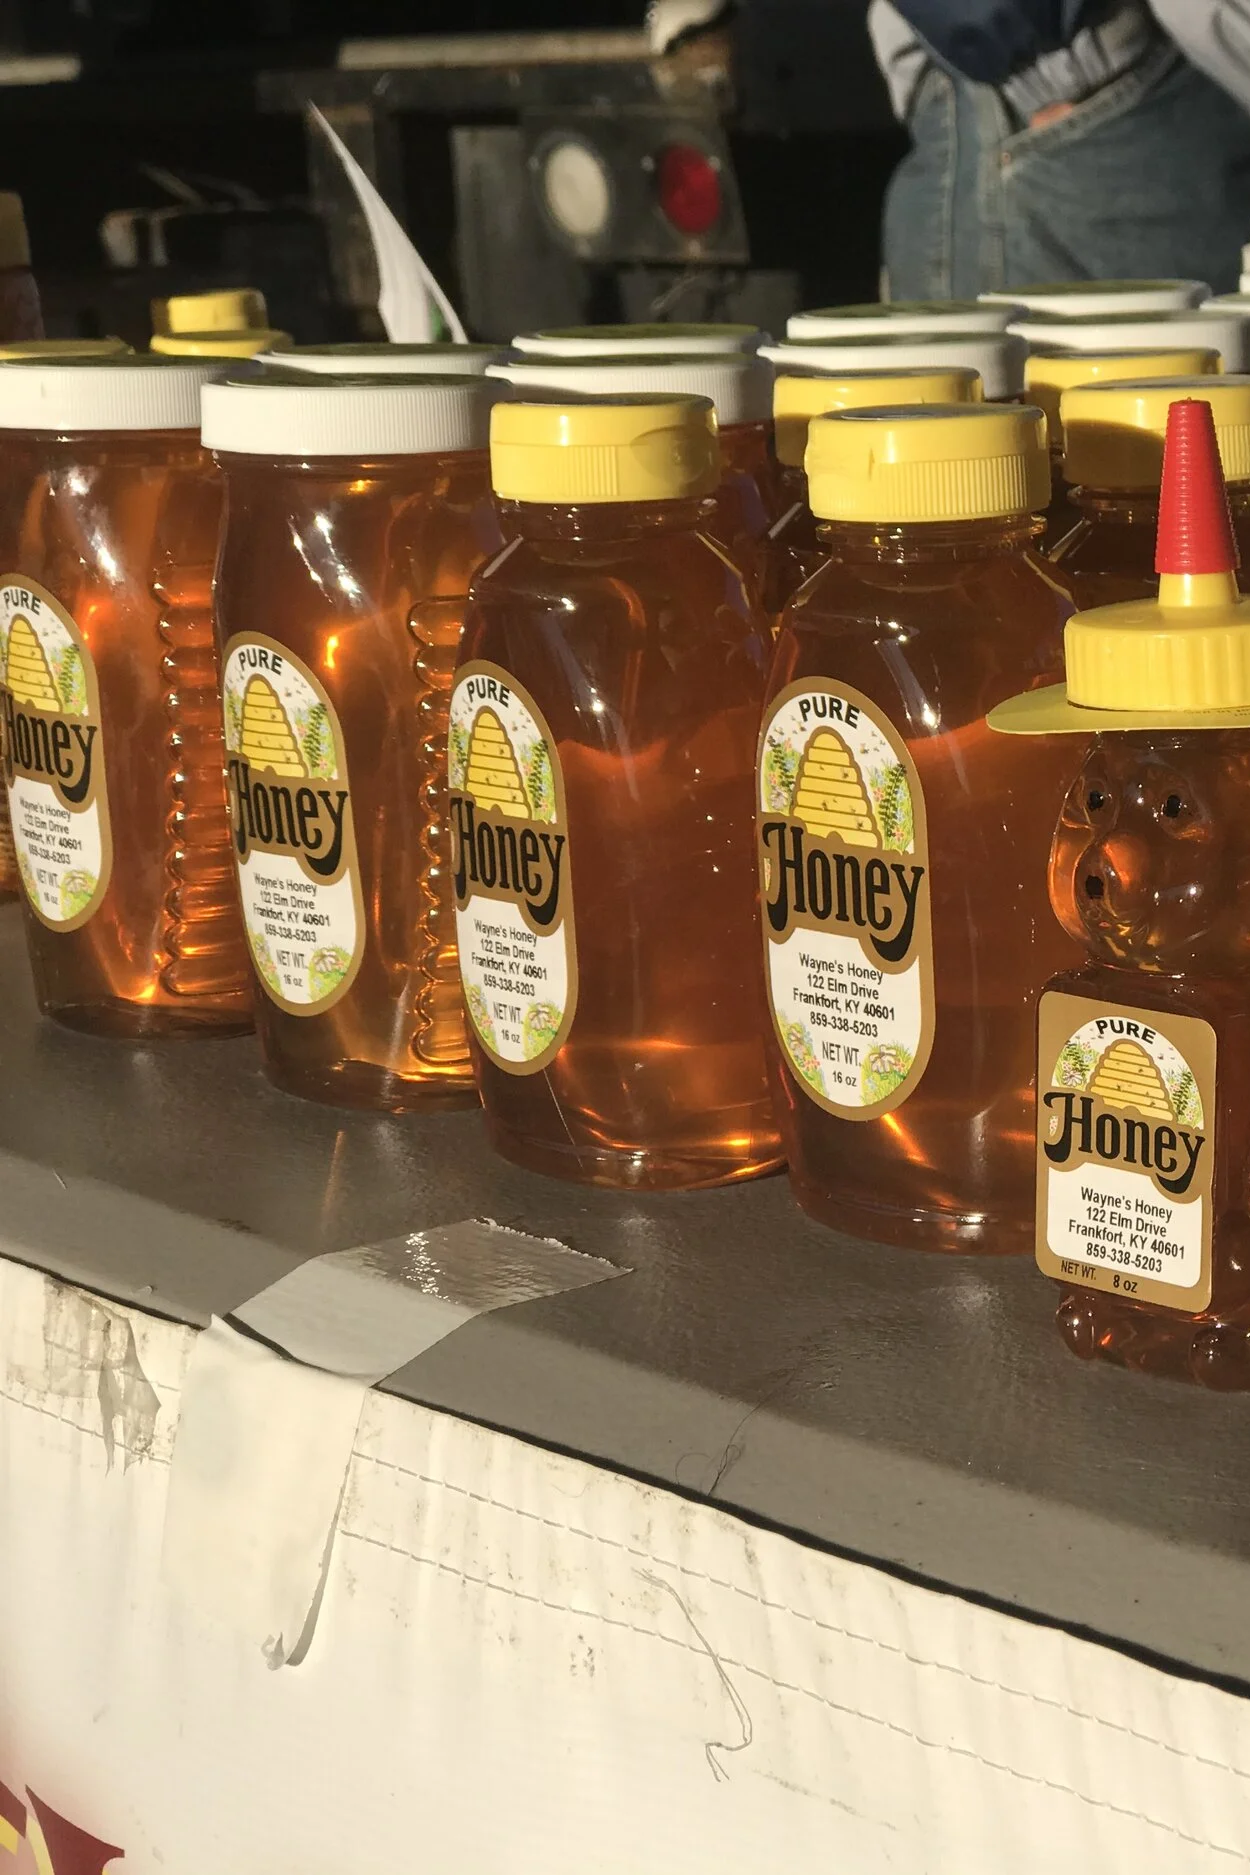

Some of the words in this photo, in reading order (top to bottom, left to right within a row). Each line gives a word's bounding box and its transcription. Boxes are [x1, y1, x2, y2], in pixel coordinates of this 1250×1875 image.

[4, 588, 41, 615] PURE
[238, 648, 283, 675] PURE
[467, 678, 511, 708] PURE
[798, 695, 860, 729] PURE
[2, 691, 97, 803] Honey
[228, 760, 348, 876] Honey
[45, 834, 56, 846] KY
[451, 797, 565, 925] Honey
[253, 872, 284, 889] Wayne's
[286, 879, 317, 897] Honey
[762, 822, 925, 962] Honey
[260, 891, 271, 903] 122
[273, 893, 289, 907] Elm
[291, 896, 315, 910] Drive
[253, 903, 285, 923] Frankfort,
[287, 912, 300, 923] KY
[302, 915, 331, 927] 40601
[265, 923, 317, 943] 859-338-5203
[474, 919, 507, 939] Wayne's
[509, 927, 538, 947] Honey
[276, 949, 291, 966] NET
[481, 938, 493, 953] 122
[495, 942, 511, 957] Elm
[513, 946, 535, 961] Drive
[471, 952, 506, 974] Frankfort,
[509, 961, 522, 976] KY
[523, 964, 547, 981] 40601
[799, 952, 844, 974] Wayne's
[847, 962, 883, 985] Honey
[283, 974, 291, 985] 16
[293, 977, 303, 987] oz
[484, 974, 535, 997] 859-338-5203
[807, 974, 824, 989] 122
[827, 978, 847, 994] Elm
[850, 982, 879, 999] Drive
[493, 1003, 507, 1020] NET
[509, 1006, 524, 1025] WT.
[793, 987, 842, 1013] Frankfort,
[845, 999, 860, 1014] KY
[863, 1002, 895, 1021] 40601
[501, 1029, 510, 1040] 16
[511, 1033, 521, 1044] oz
[810, 1011, 878, 1038] 859-338-5203
[1095, 1019, 1156, 1045] PURE
[822, 1041, 841, 1062] NET
[843, 1046, 862, 1067] WT.
[832, 1070, 842, 1084] 16
[845, 1074, 857, 1087] oz
[1043, 1091, 1206, 1194] Honey
[1080, 1186, 1132, 1211] Wayne's
[1135, 1198, 1173, 1224] Honey
[1086, 1206, 1106, 1223] 122
[1109, 1212, 1133, 1229] Elm
[1135, 1217, 1167, 1237] Drive
[1068, 1219, 1126, 1248] Frankfort,
[1129, 1233, 1148, 1250] KY
[1150, 1239, 1185, 1259] 40601
[1086, 1242, 1163, 1273] 859-338-5203
[1060, 1260, 1080, 1275] NET
[1081, 1265, 1097, 1281] WT.
[1112, 1274, 1120, 1289] 8
[1123, 1280, 1138, 1293] oz
